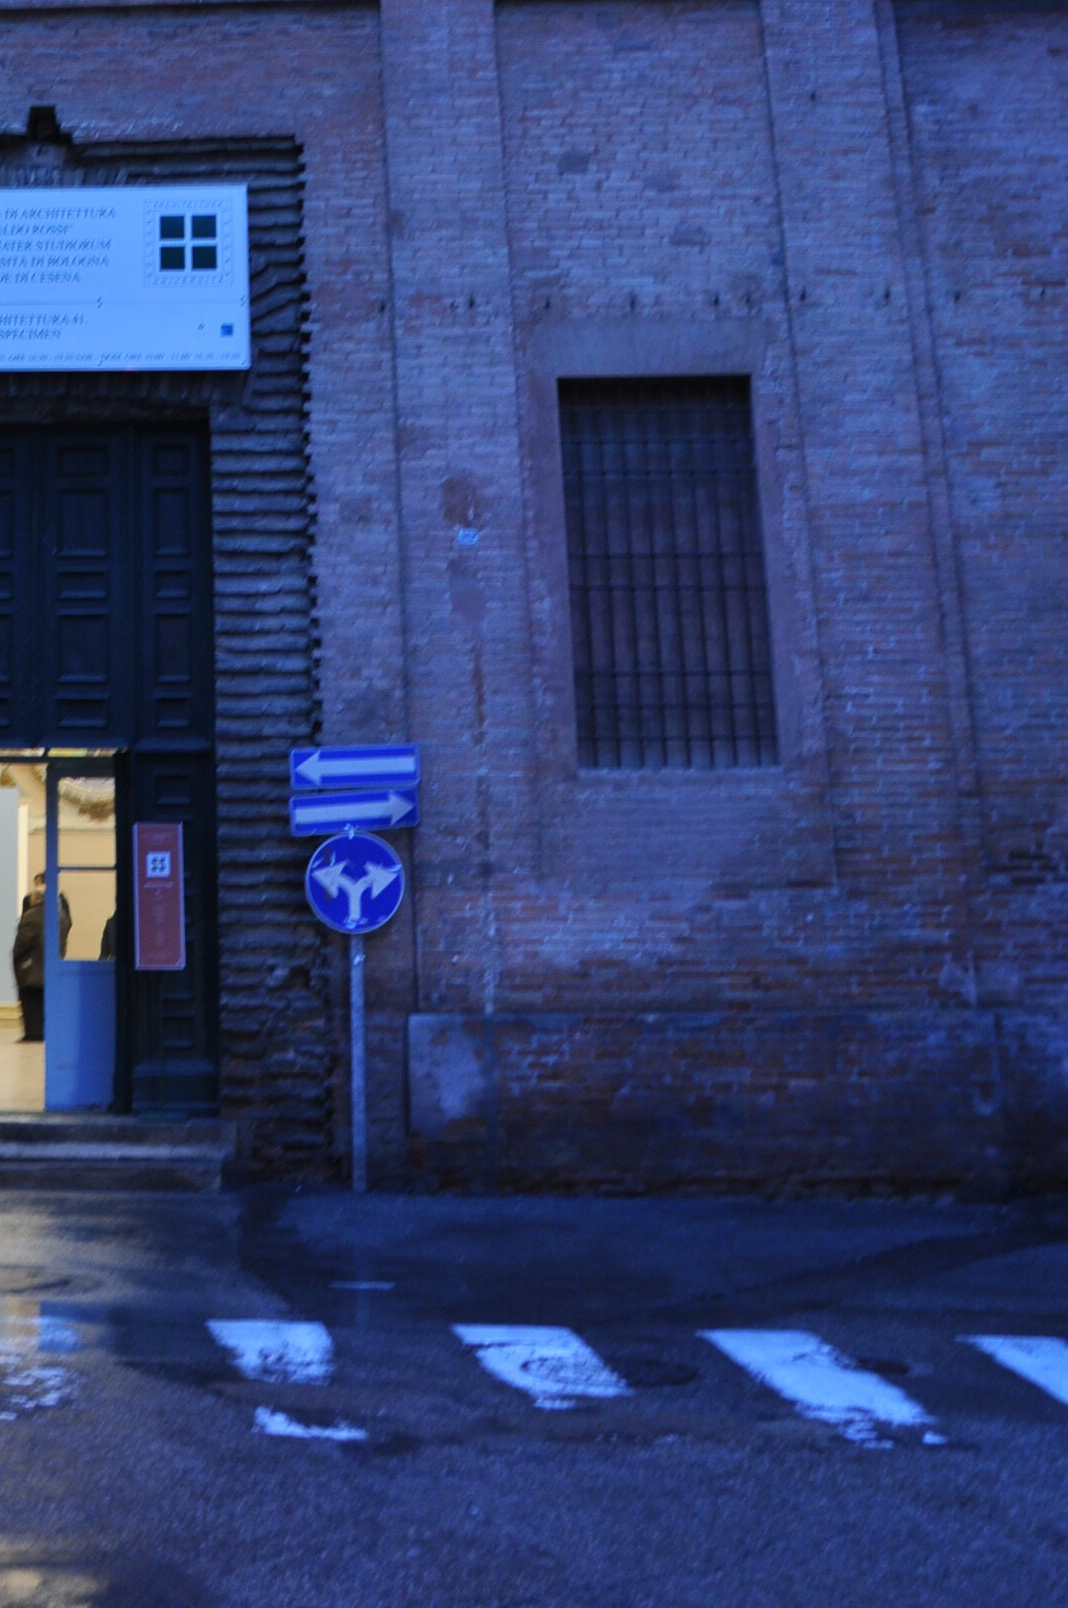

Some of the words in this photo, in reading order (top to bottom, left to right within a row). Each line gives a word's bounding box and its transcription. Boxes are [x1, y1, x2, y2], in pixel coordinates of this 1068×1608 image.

[4, 207, 19, 221] DI
[21, 207, 117, 220] ARCHITETTURA
[36, 238, 112, 252] STUDIORUM
[30, 255, 45, 268] DI
[47, 254, 110, 267] BOLOGNA
[14, 272, 29, 284] DI
[30, 271, 81, 284] CESENA
